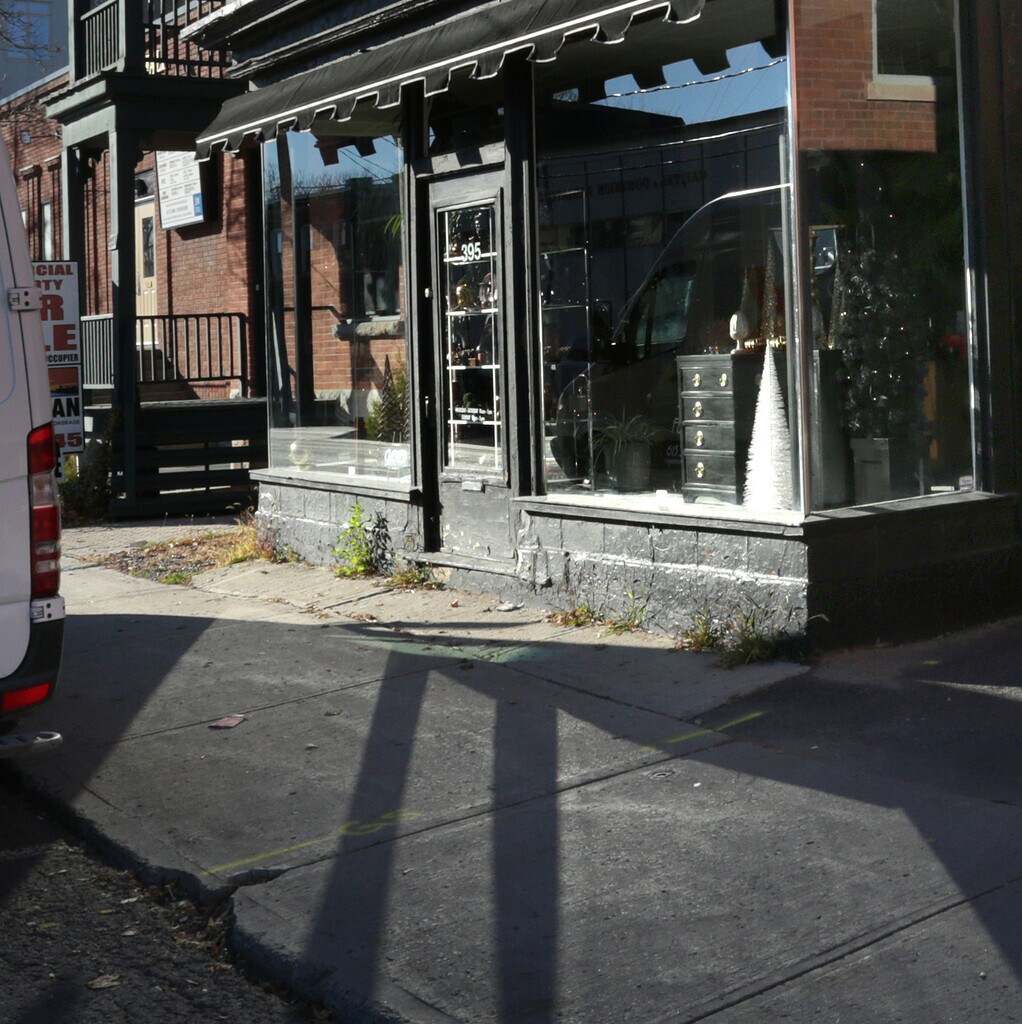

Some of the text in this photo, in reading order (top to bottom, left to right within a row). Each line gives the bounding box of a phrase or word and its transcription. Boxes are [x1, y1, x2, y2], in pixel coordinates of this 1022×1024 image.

[461, 241, 482, 263] 395
[32, 264, 74, 276] CIAL
[47, 353, 79, 363] CCUPIER
